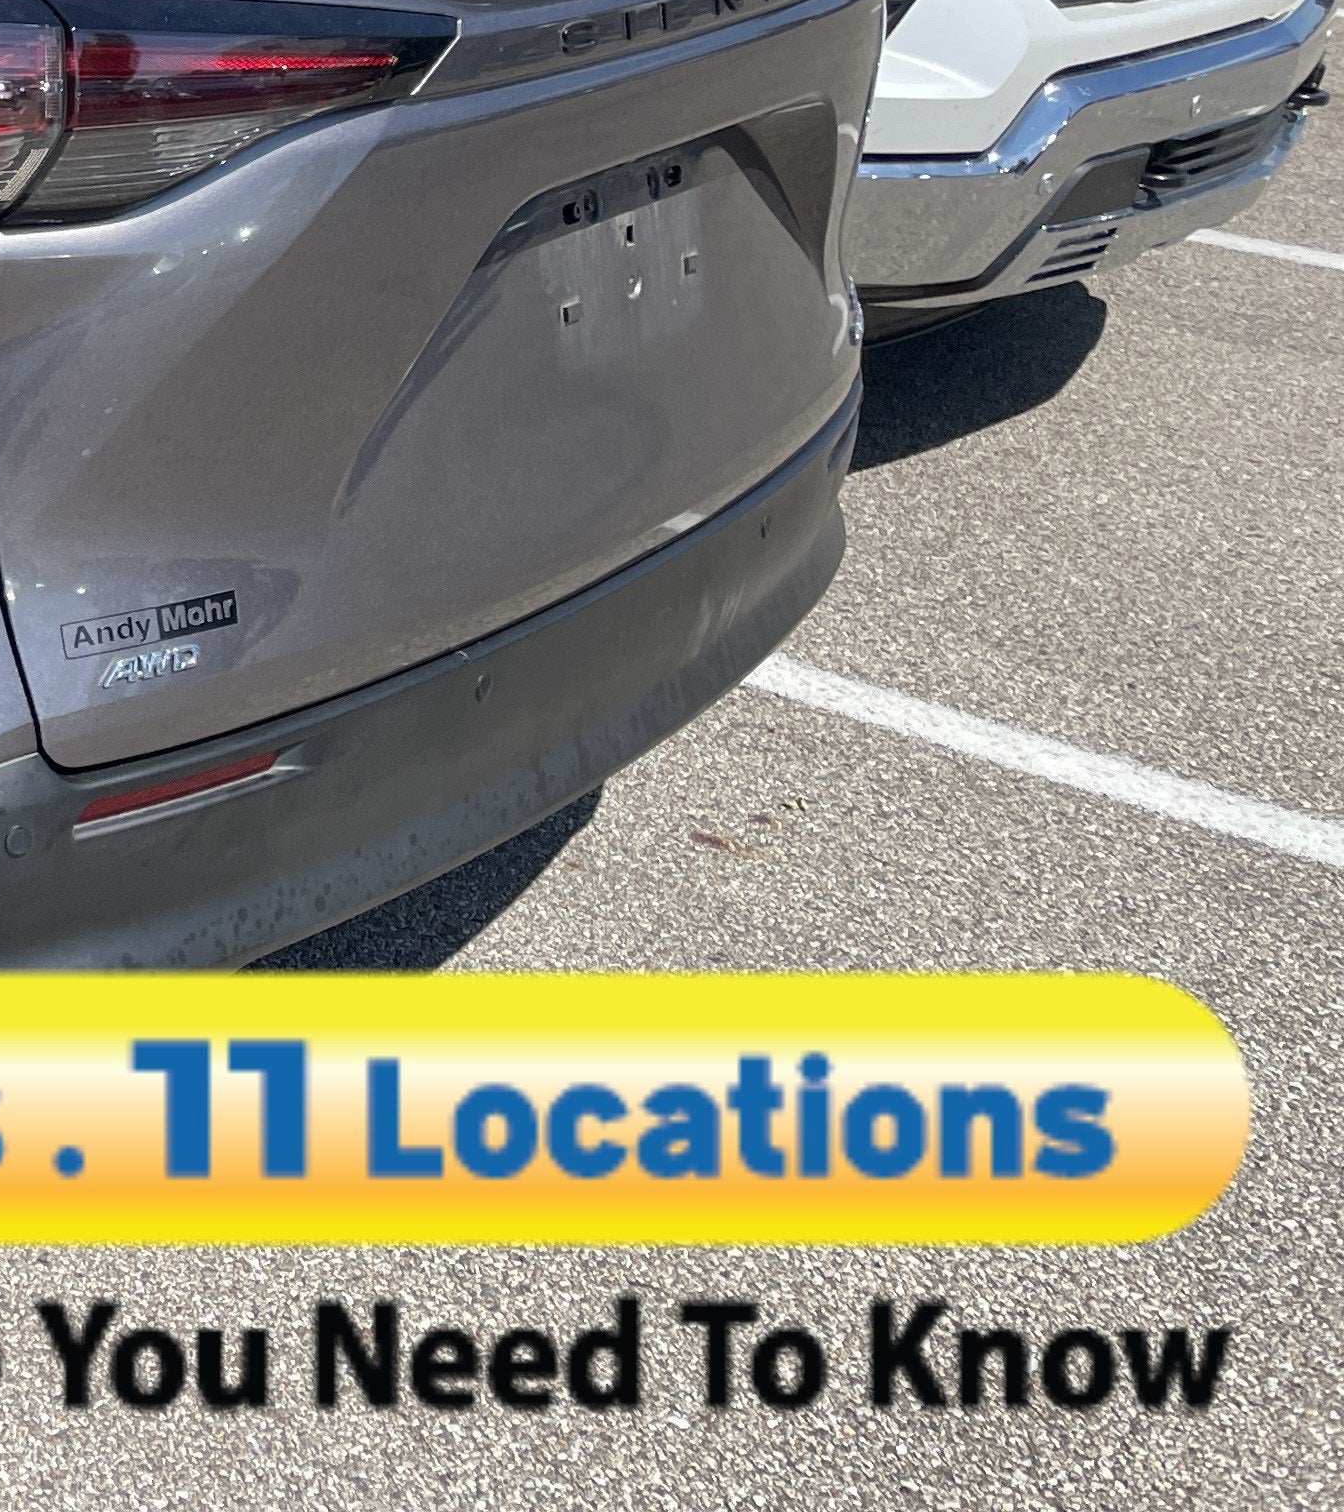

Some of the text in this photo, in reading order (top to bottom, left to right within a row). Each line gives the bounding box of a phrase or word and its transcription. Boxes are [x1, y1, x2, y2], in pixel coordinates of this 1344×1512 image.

[73, 598, 235, 649] Andy Mohr
[99, 643, 201, 689] AWD
